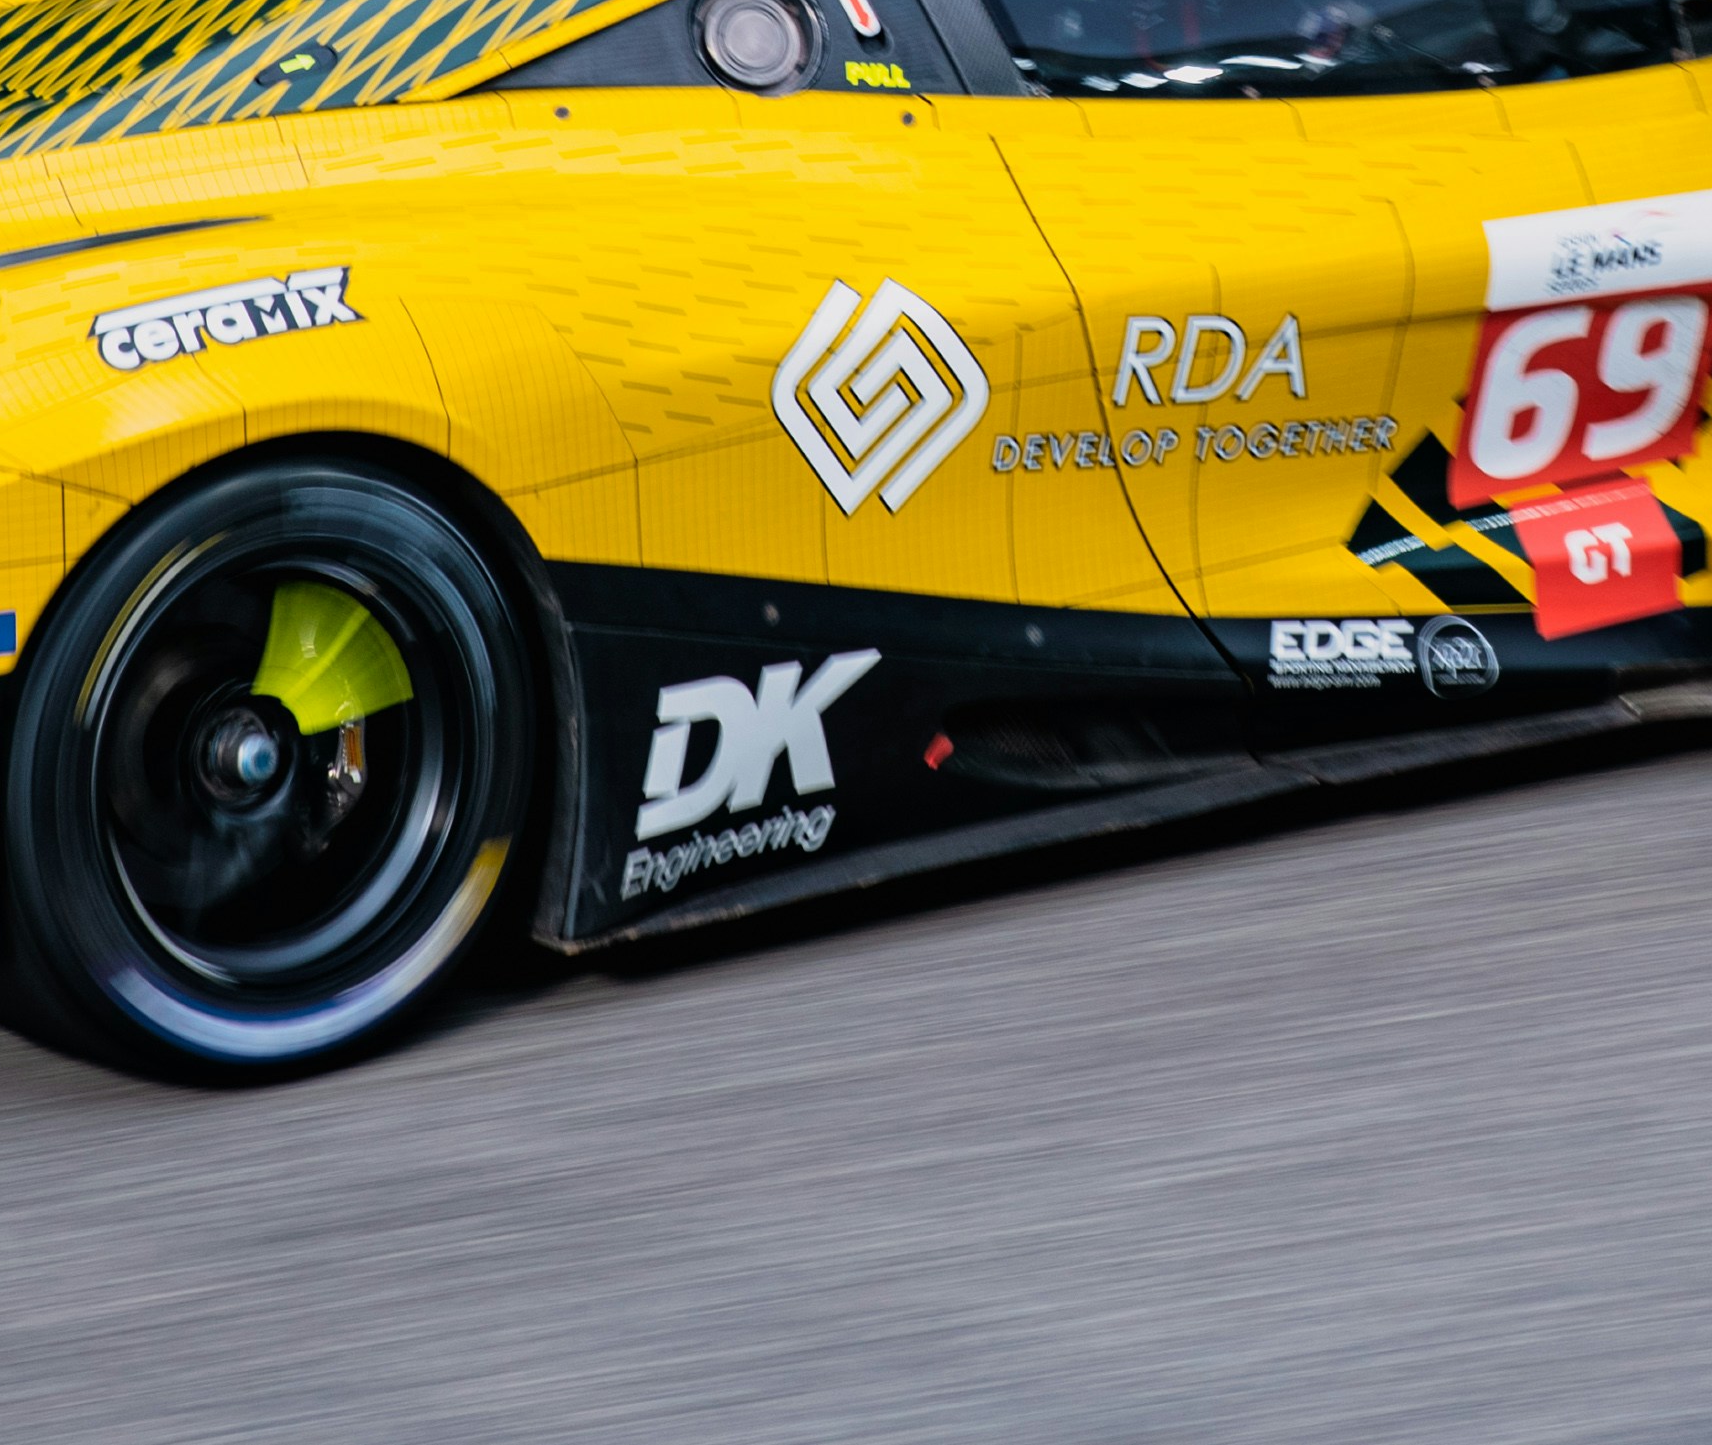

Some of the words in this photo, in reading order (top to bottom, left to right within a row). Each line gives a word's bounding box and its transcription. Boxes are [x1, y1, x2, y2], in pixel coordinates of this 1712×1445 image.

[845, 61, 911, 89] PULL
[1113, 313, 1307, 406] RDA
[1470, 296, 1709, 481] 69
[990, 427, 1179, 473] DEVELOP
[1195, 414, 1399, 464] TOGETHER
[1564, 520, 1634, 586] GT
[1270, 619, 1415, 661] EDGE
[634, 647, 883, 842] DK
[620, 804, 837, 902] Engineering
